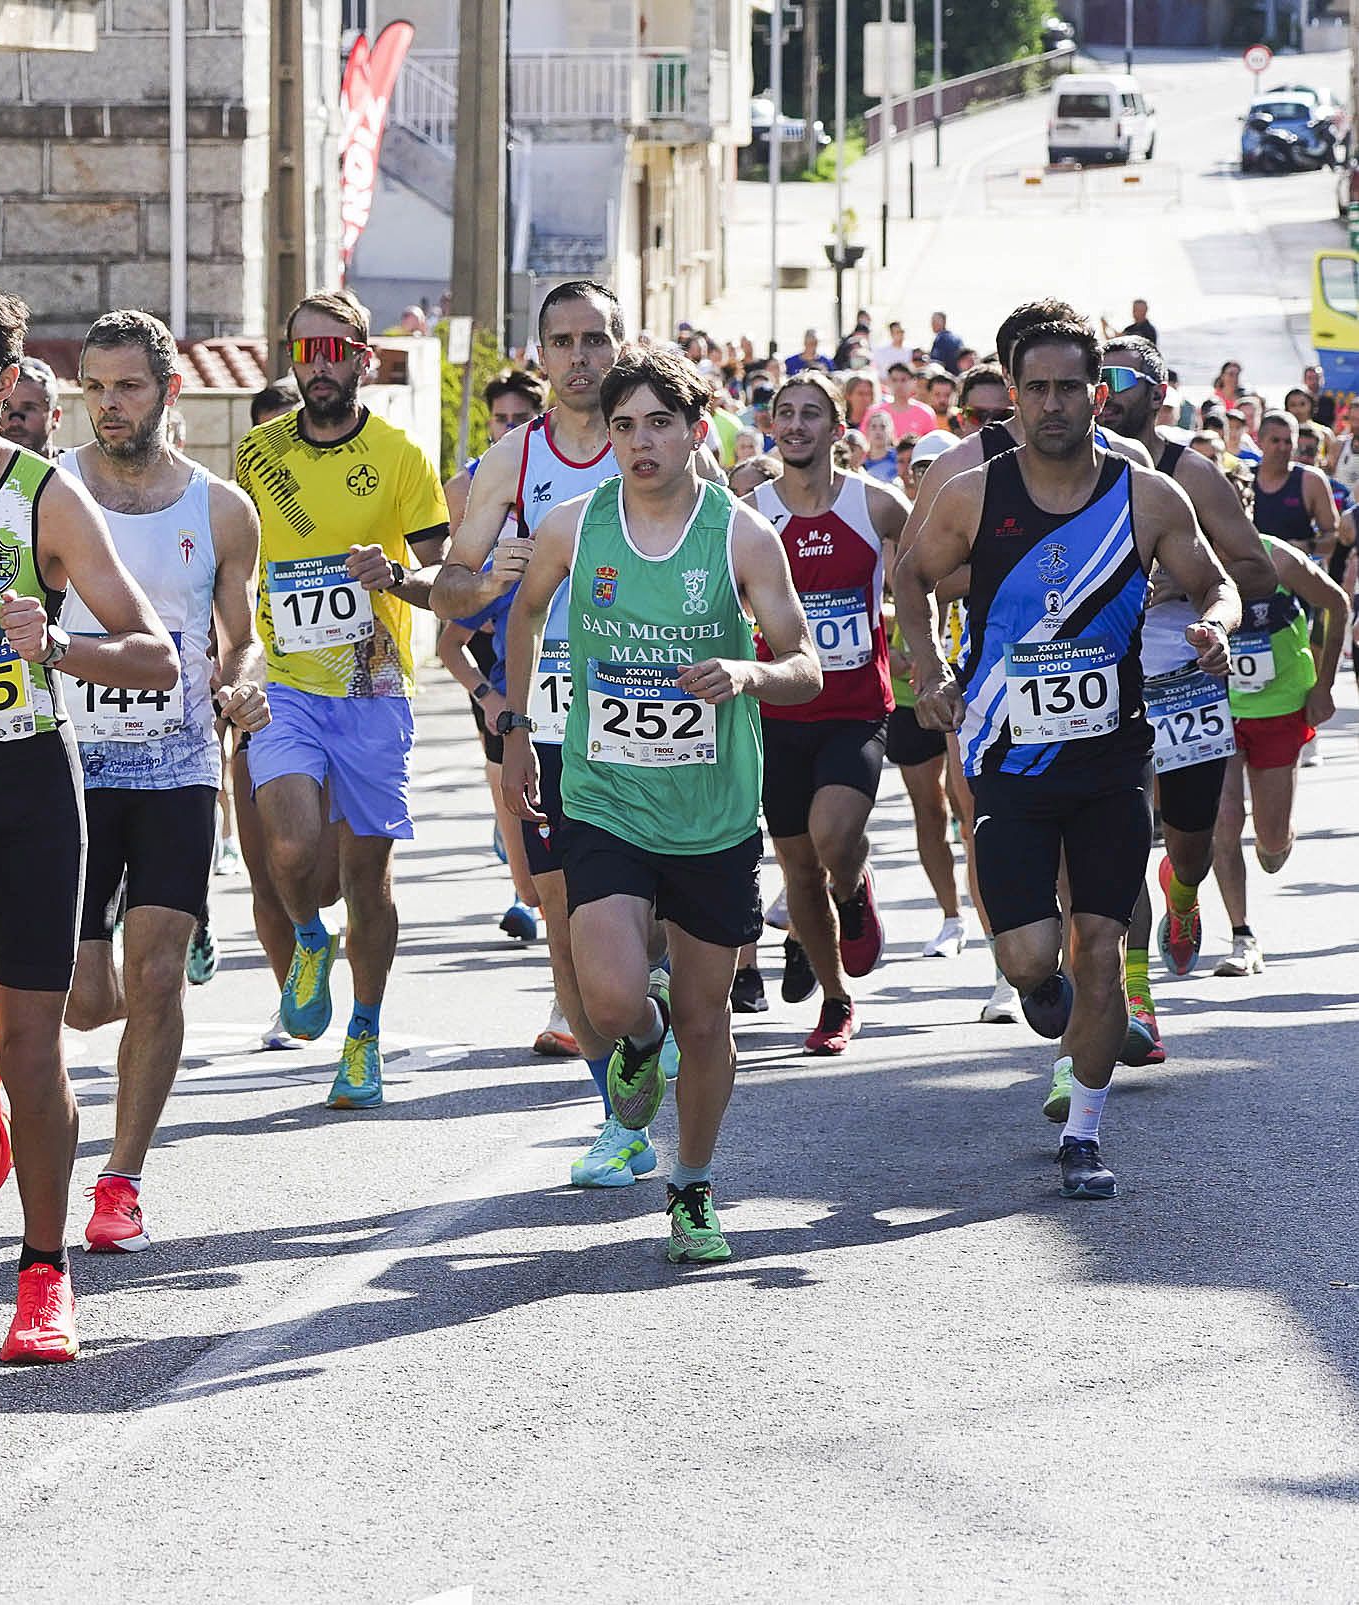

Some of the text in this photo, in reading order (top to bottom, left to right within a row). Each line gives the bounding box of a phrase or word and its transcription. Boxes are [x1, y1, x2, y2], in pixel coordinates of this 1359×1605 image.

[295, 577, 324, 588] POIO
[283, 586, 357, 627] 170
[582, 613, 726, 641] SAN MIGUEL
[816, 616, 860, 650] 01
[609, 644, 694, 664] MARÍN
[1012, 653, 1053, 663] MARATÓN
[1064, 646, 1106, 659] FÁTIMA
[1037, 642, 1071, 652] XXXVII
[625, 667, 662, 677] XXXVII
[1038, 661, 1071, 673] POIO
[596, 671, 641, 686] MARATÓN
[654, 677, 676, 687] FÁT
[624, 687, 661, 697] POIO
[1019, 671, 1108, 716] 130
[1166, 700, 1192, 712] POIO
[601, 698, 704, 740] 252
[1157, 704, 1224, 746] 125
